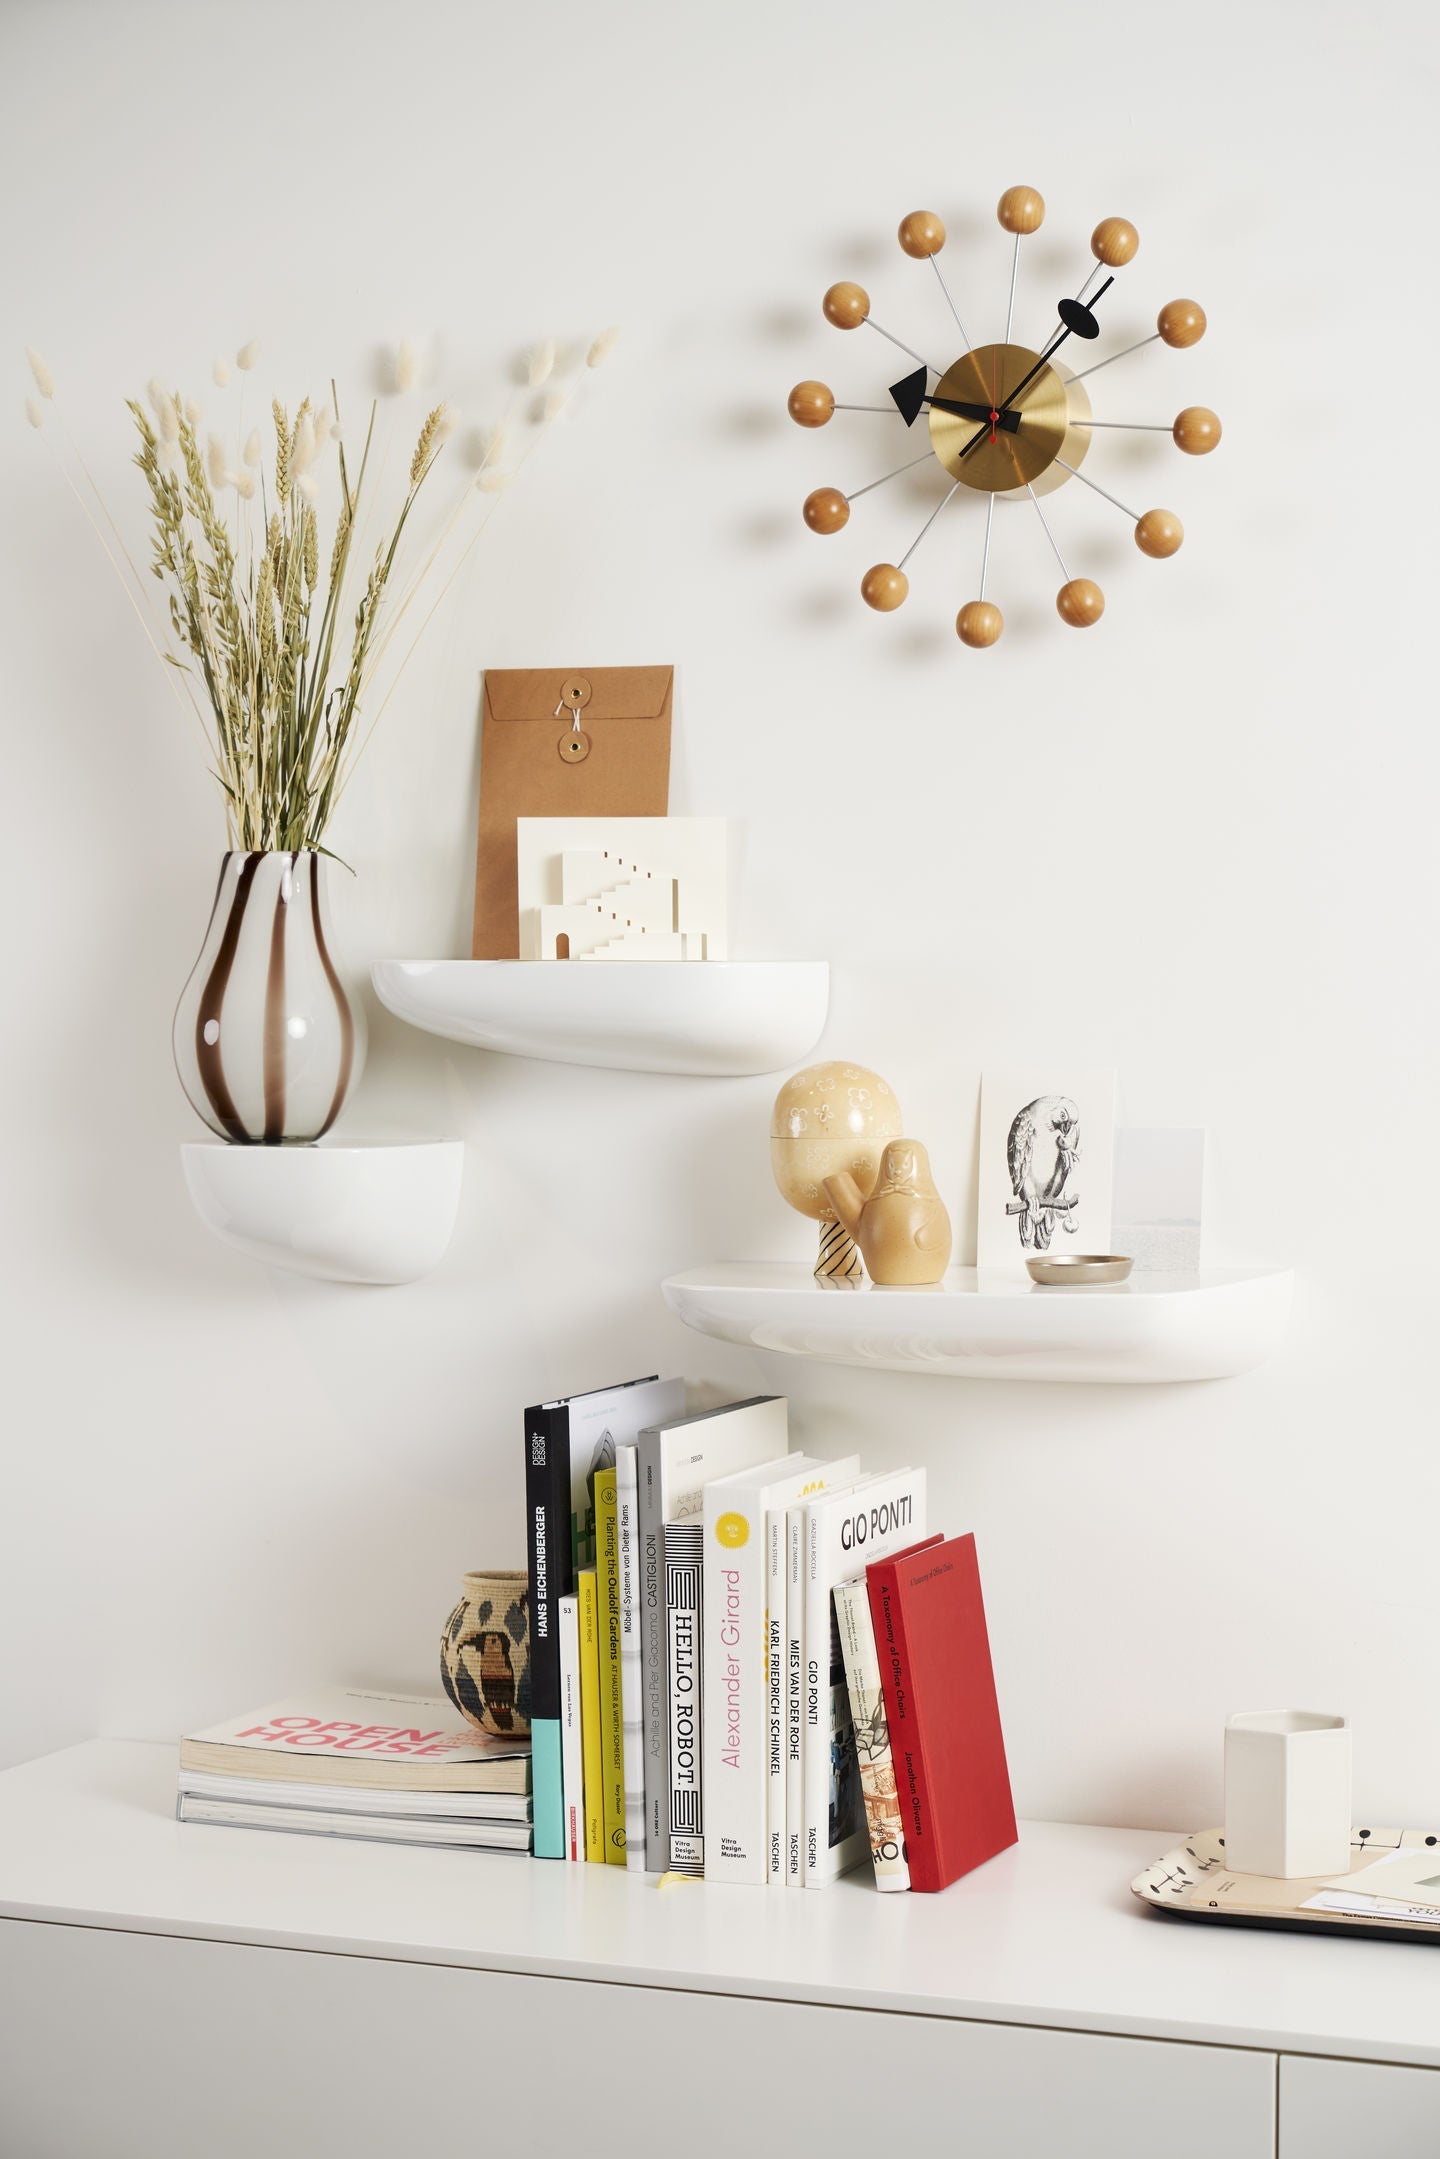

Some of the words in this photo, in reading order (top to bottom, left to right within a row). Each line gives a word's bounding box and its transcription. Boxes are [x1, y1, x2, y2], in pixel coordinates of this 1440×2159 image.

[538, 1435, 546, 1466] DESIGN
[621, 1504, 629, 1525] Rams
[841, 1513, 867, 1551] GIO
[871, 1494, 912, 1540] PONTI
[535, 1506, 547, 1600] EICHENBERGER
[605, 1516, 615, 1557] Planting
[622, 1528, 630, 1554] Dieter
[646, 1534, 657, 1608] CASTIGLIONI
[608, 1577, 619, 1616] Oudolf
[881, 1586, 889, 1594] A
[537, 1603, 548, 1637] HANS
[720, 1570, 740, 1646] Girard
[882, 1595, 895, 1644] Taxonomy
[609, 1616, 620, 1660] Gardens
[649, 1612, 658, 1668] Giacomo
[771, 1620, 780, 1650] KARL
[890, 1647, 899, 1656] of
[611, 1664, 618, 1674] AT
[674, 1615, 693, 1698] HELLO,
[790, 1639, 799, 1668] MIES
[611, 1674, 619, 1701] HAUSER
[650, 1671, 658, 1691] Pier
[771, 1653, 780, 1715] FRIEDRICH
[790, 1670, 800, 1695] VAN
[808, 1660, 818, 1684] GIO
[891, 1656, 901, 1687] Office
[612, 1709, 620, 1732] WIRTH
[650, 1693, 659, 1716] and
[721, 1653, 740, 1769] Alexander
[790, 1700, 799, 1723] DER
[808, 1688, 818, 1725] PONTI
[896, 1688, 906, 1720] Chairs
[235, 1725, 462, 1756] HOUSE
[268, 1716, 445, 1743] OPEN
[651, 1720, 660, 1758] Achille
[677, 1704, 694, 1785] ROBOT.
[790, 1727, 799, 1760] ROHE
[613, 1734, 621, 1770] SOMERSET
[771, 1719, 780, 1776] SCHINKEL
[905, 1752, 917, 1795] Jonathan
[912, 1796, 923, 1836] Olivares
[675, 1853, 700, 1861] Museum
[721, 1844, 742, 1852] Design
[721, 1851, 747, 1859] Museum
[771, 1832, 780, 1873] TASCHEN
[790, 1833, 799, 1874] TASCHEN
[808, 1827, 817, 1868] TASCHEN
